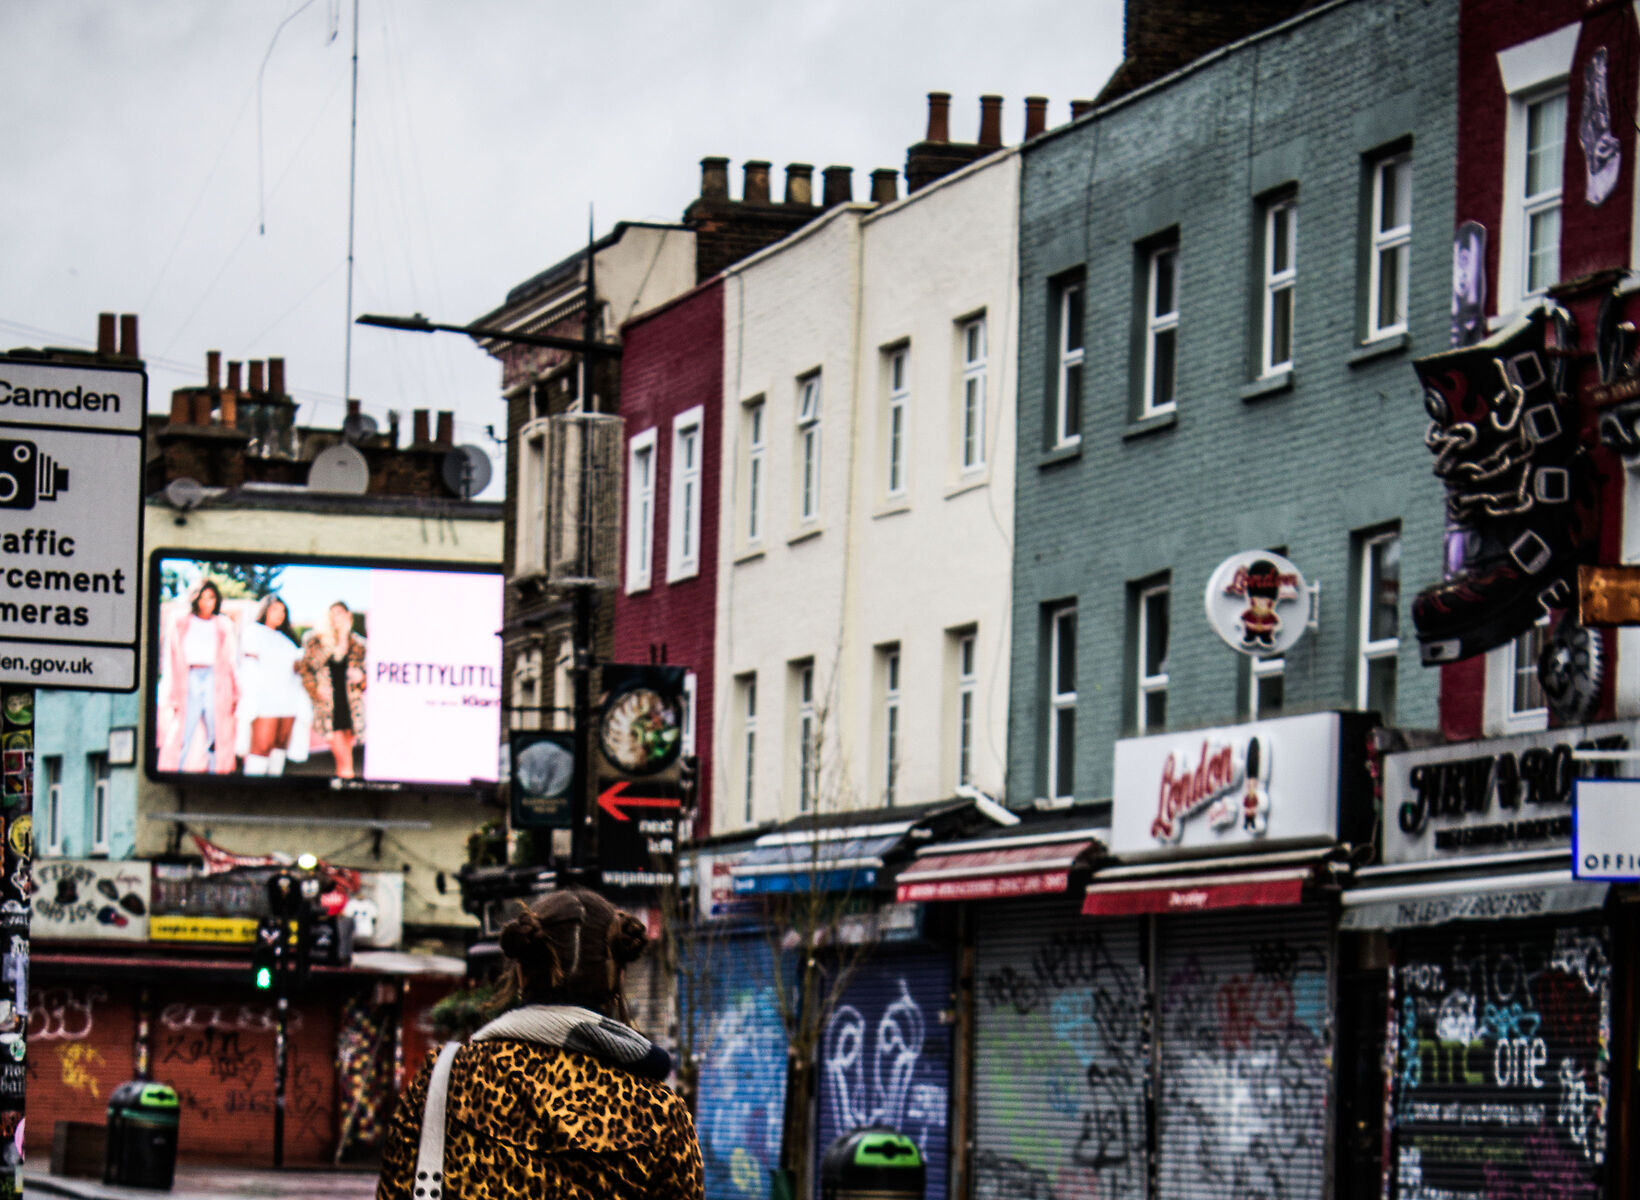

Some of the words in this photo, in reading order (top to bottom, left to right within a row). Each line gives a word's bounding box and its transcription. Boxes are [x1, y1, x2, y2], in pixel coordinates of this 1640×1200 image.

[0, 380, 120, 412] Camden
[0, 528, 75, 557] affic
[1585, 854, 1640, 870] OFFI
[1494, 1038, 1547, 1088] one
